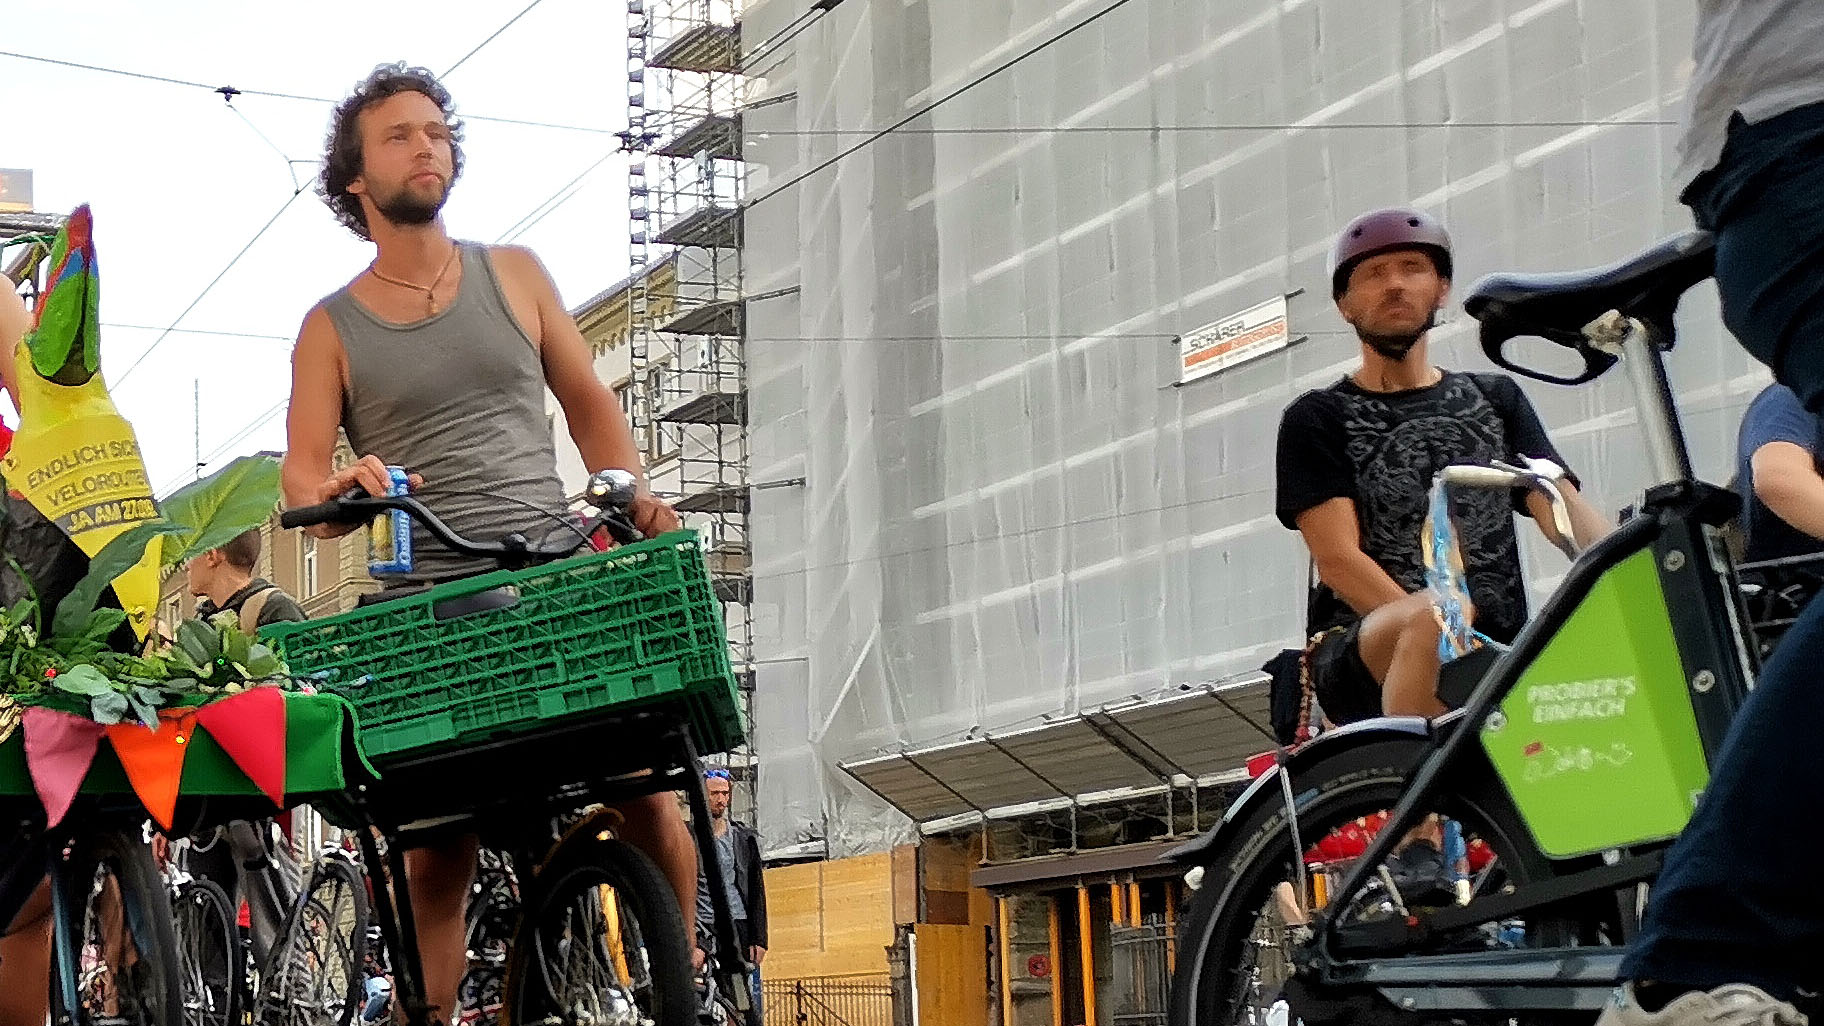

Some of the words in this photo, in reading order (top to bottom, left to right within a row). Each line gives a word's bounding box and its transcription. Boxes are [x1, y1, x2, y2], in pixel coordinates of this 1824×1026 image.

[27, 442, 108, 490] ENDLICH
[66, 510, 95, 533] JA
[94, 502, 122, 525] AM
[1532, 697, 1627, 724] EINFACH
